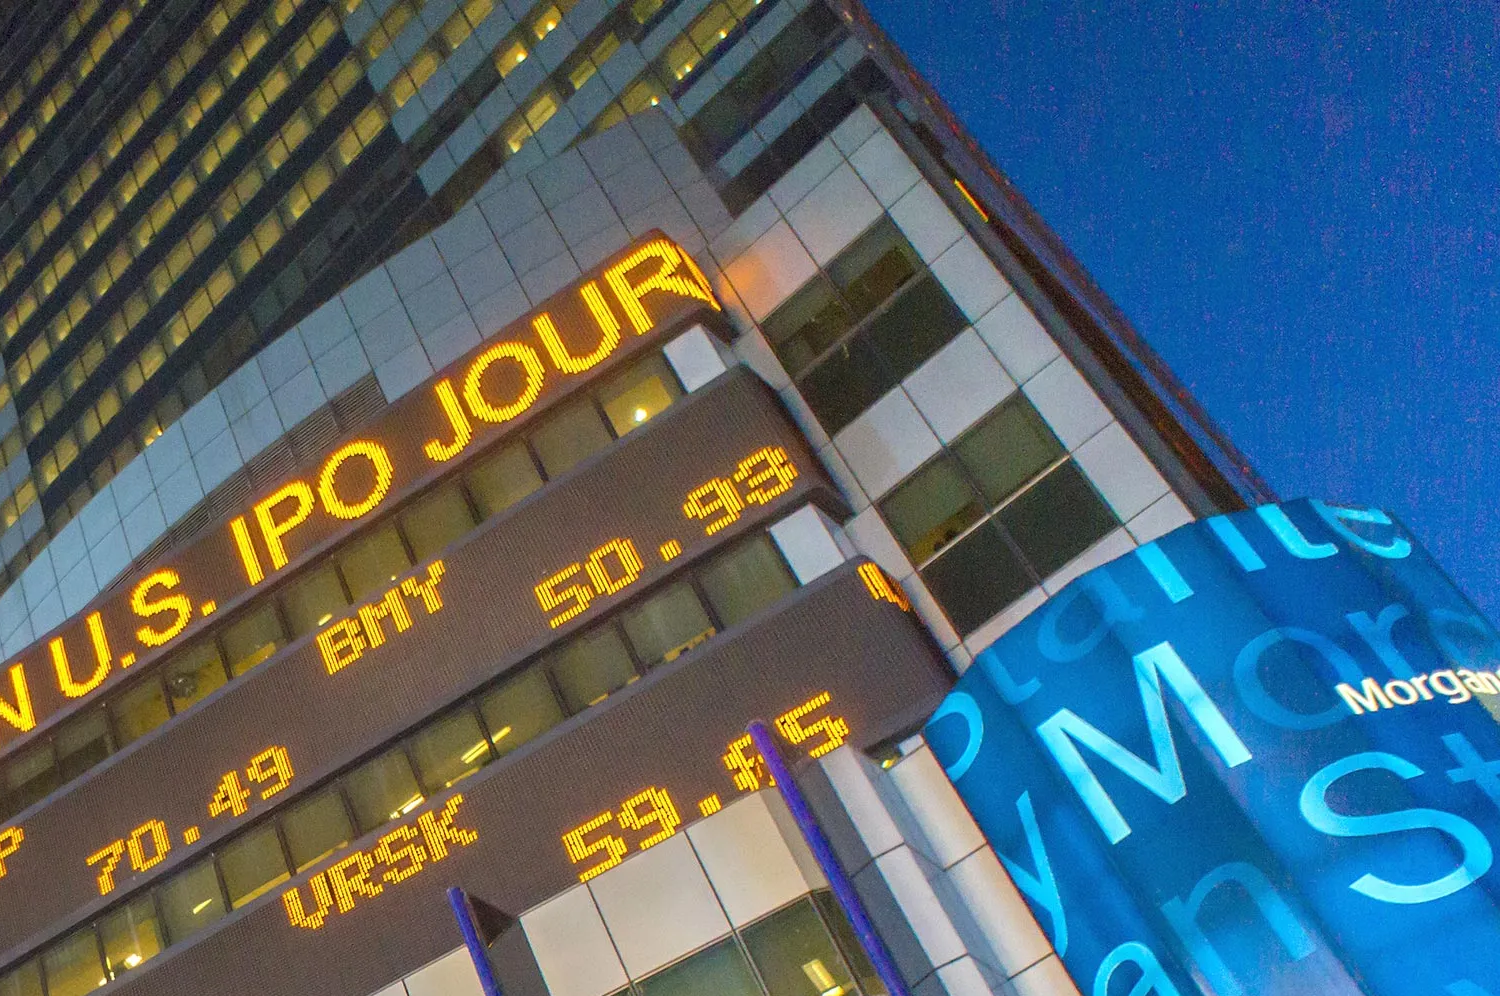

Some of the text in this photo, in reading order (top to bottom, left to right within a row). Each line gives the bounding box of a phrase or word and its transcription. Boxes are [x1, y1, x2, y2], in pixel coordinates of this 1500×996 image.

[49, 566, 217, 699] U.S.
[229, 438, 394, 585] IPO
[425, 238, 722, 463] JOUR
[87, 744, 294, 896] 70.49
[315, 559, 445, 675] BMY
[534, 445, 799, 628] 50.93
[1334, 667, 1499, 715] Morgan
